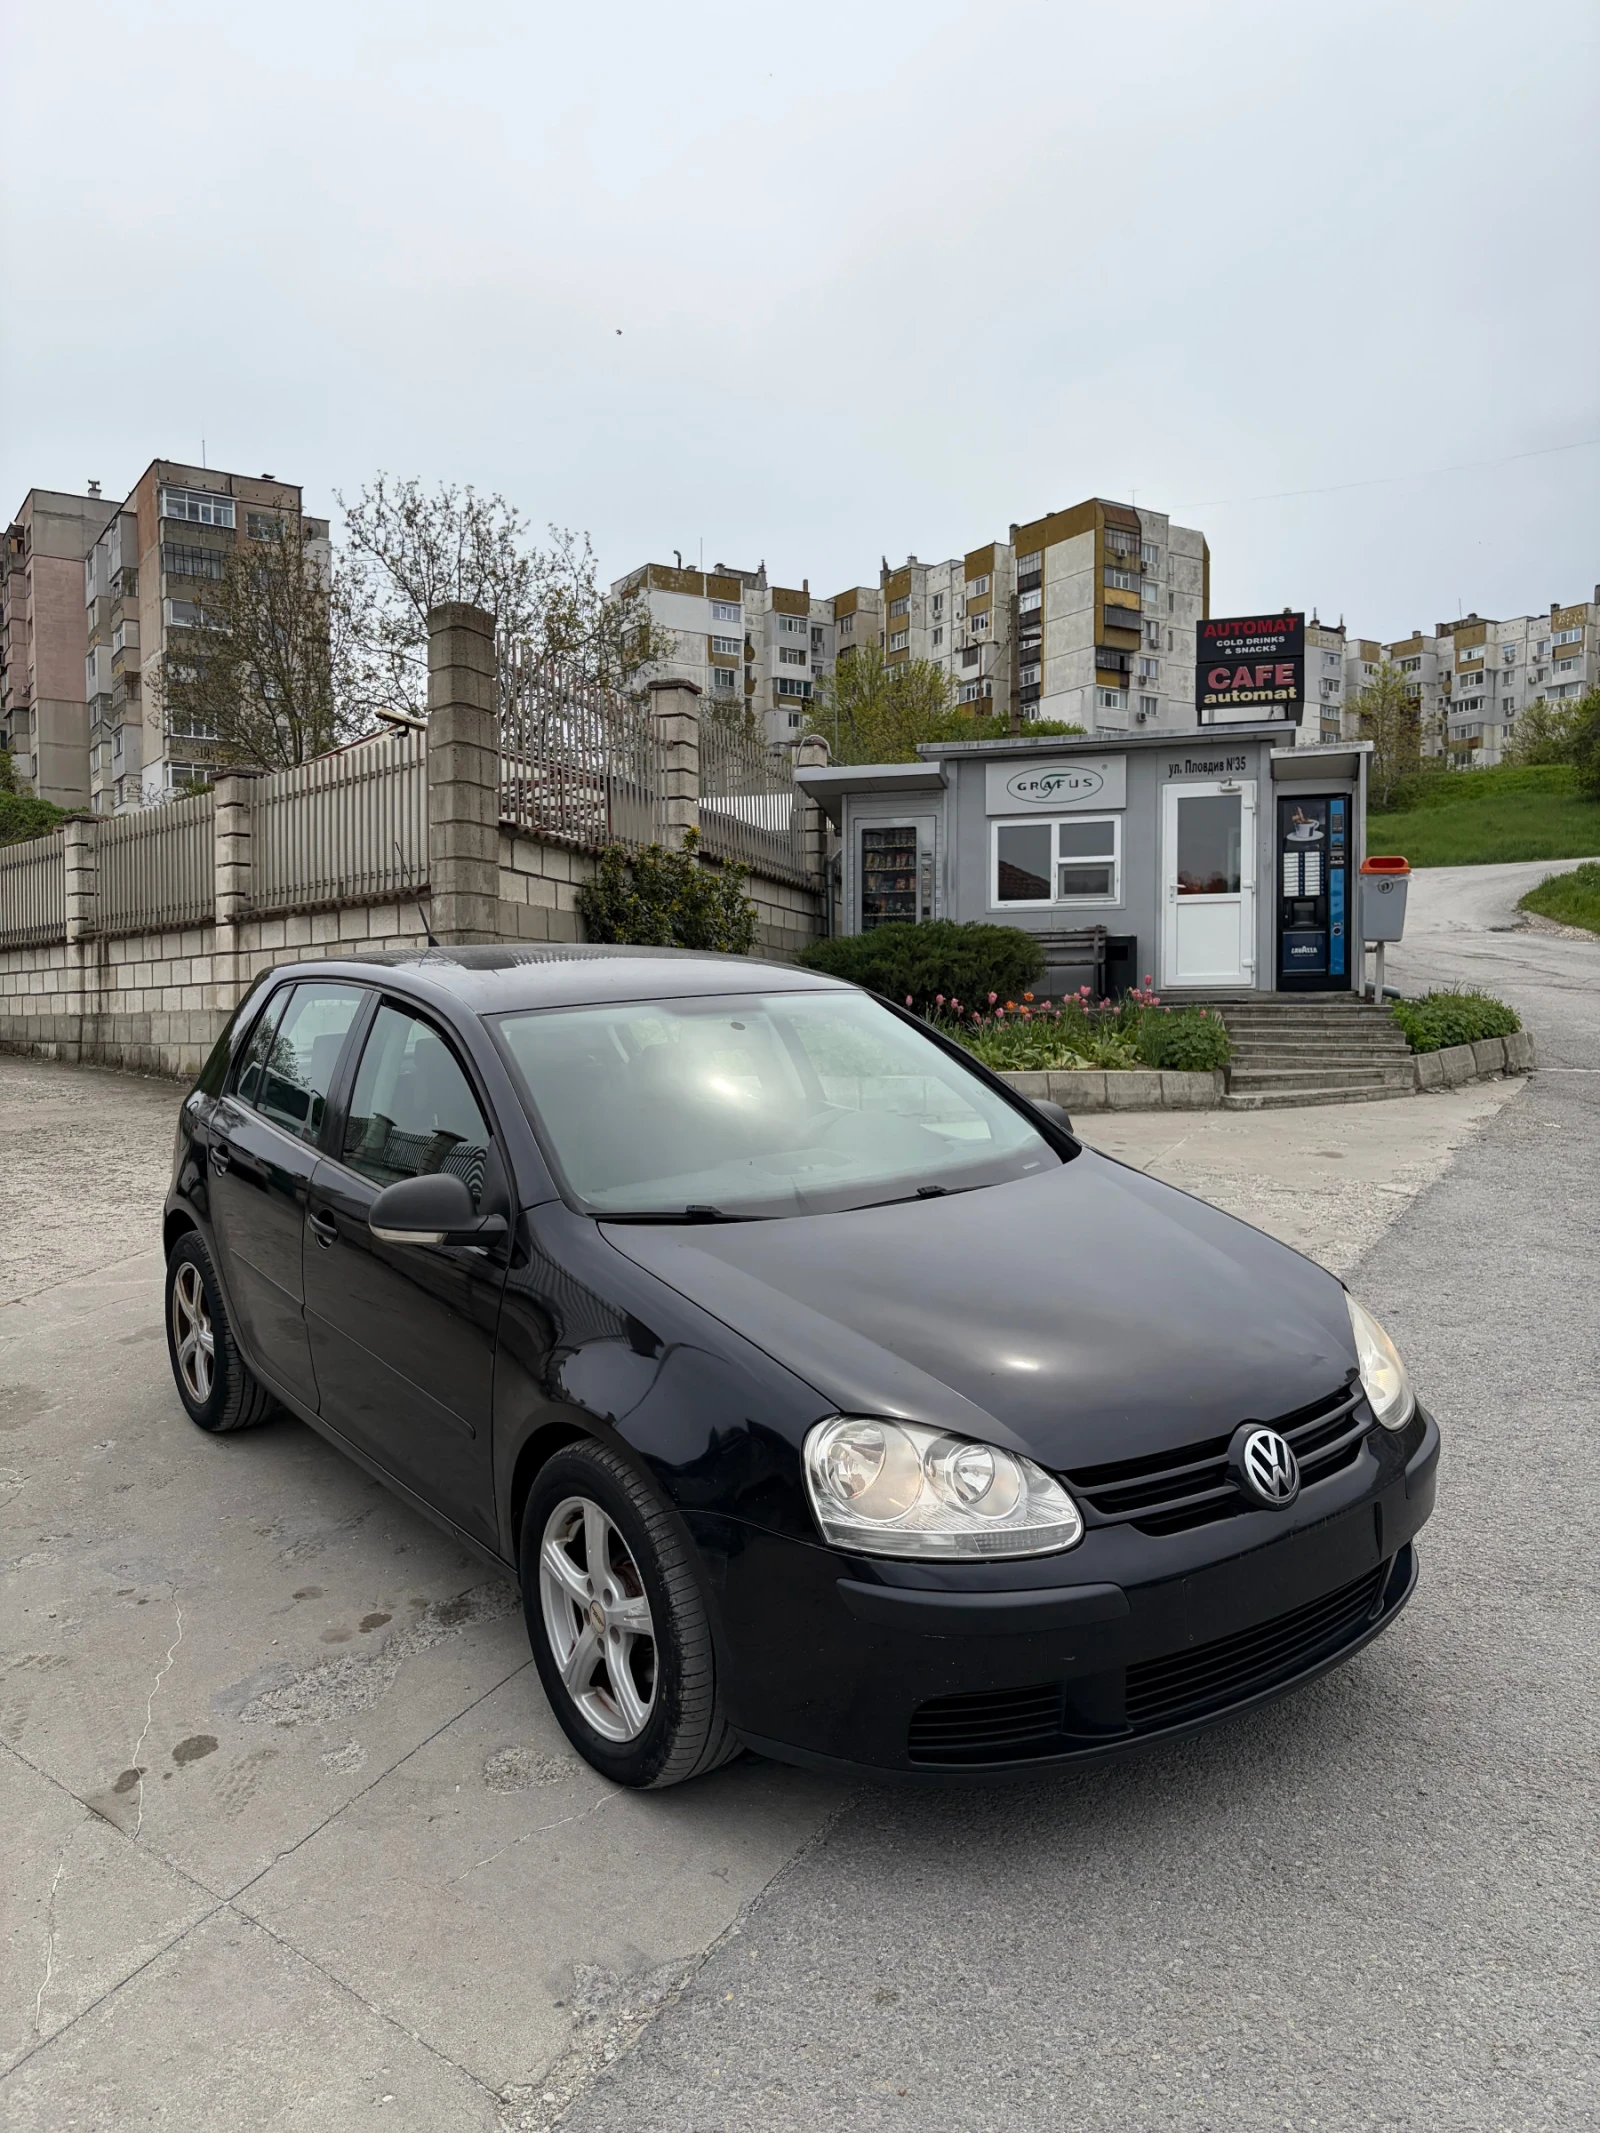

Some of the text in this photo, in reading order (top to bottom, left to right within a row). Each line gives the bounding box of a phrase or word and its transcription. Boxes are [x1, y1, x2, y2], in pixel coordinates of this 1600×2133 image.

[1204, 618, 1298, 638] AUTOMAT
[1216, 636, 1285, 647] COLD DRINKS
[1235, 645, 1277, 654] SNACKS
[1207, 663, 1295, 690] CAFE
[1203, 686, 1297, 704] automat
[1168, 764, 1182, 778] ул.
[1185, 759, 1224, 775] Пловдив
[1017, 775, 1093, 795] GRAFUS
[1244, 1429, 1300, 1504] VW
